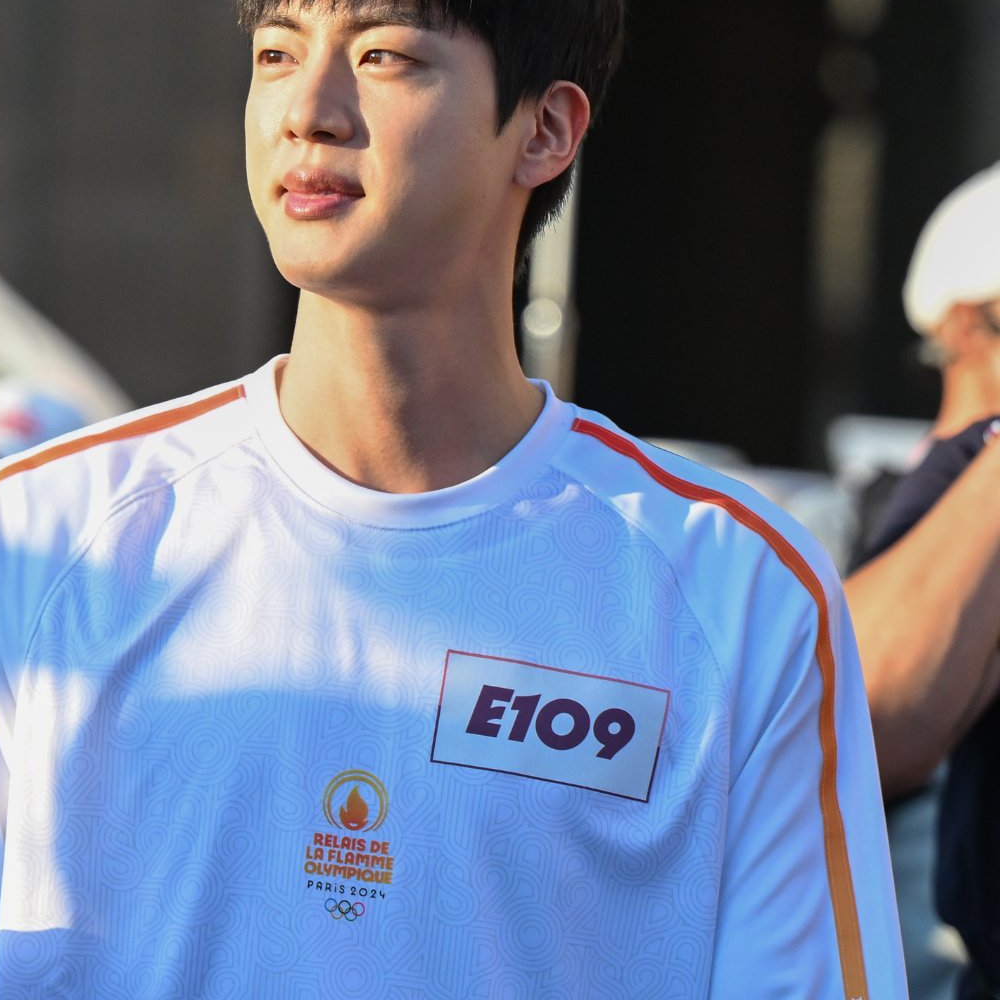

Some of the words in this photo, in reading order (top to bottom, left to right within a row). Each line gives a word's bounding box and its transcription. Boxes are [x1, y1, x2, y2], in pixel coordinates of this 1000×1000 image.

[465, 684, 636, 760] E109
[313, 832, 366, 852] RELAIS
[370, 840, 390, 855] DE
[305, 846, 324, 860] LA
[328, 849, 394, 871] FLAMME
[304, 860, 393, 884] OLYMPIQUE
[350, 886, 385, 899] 2024
